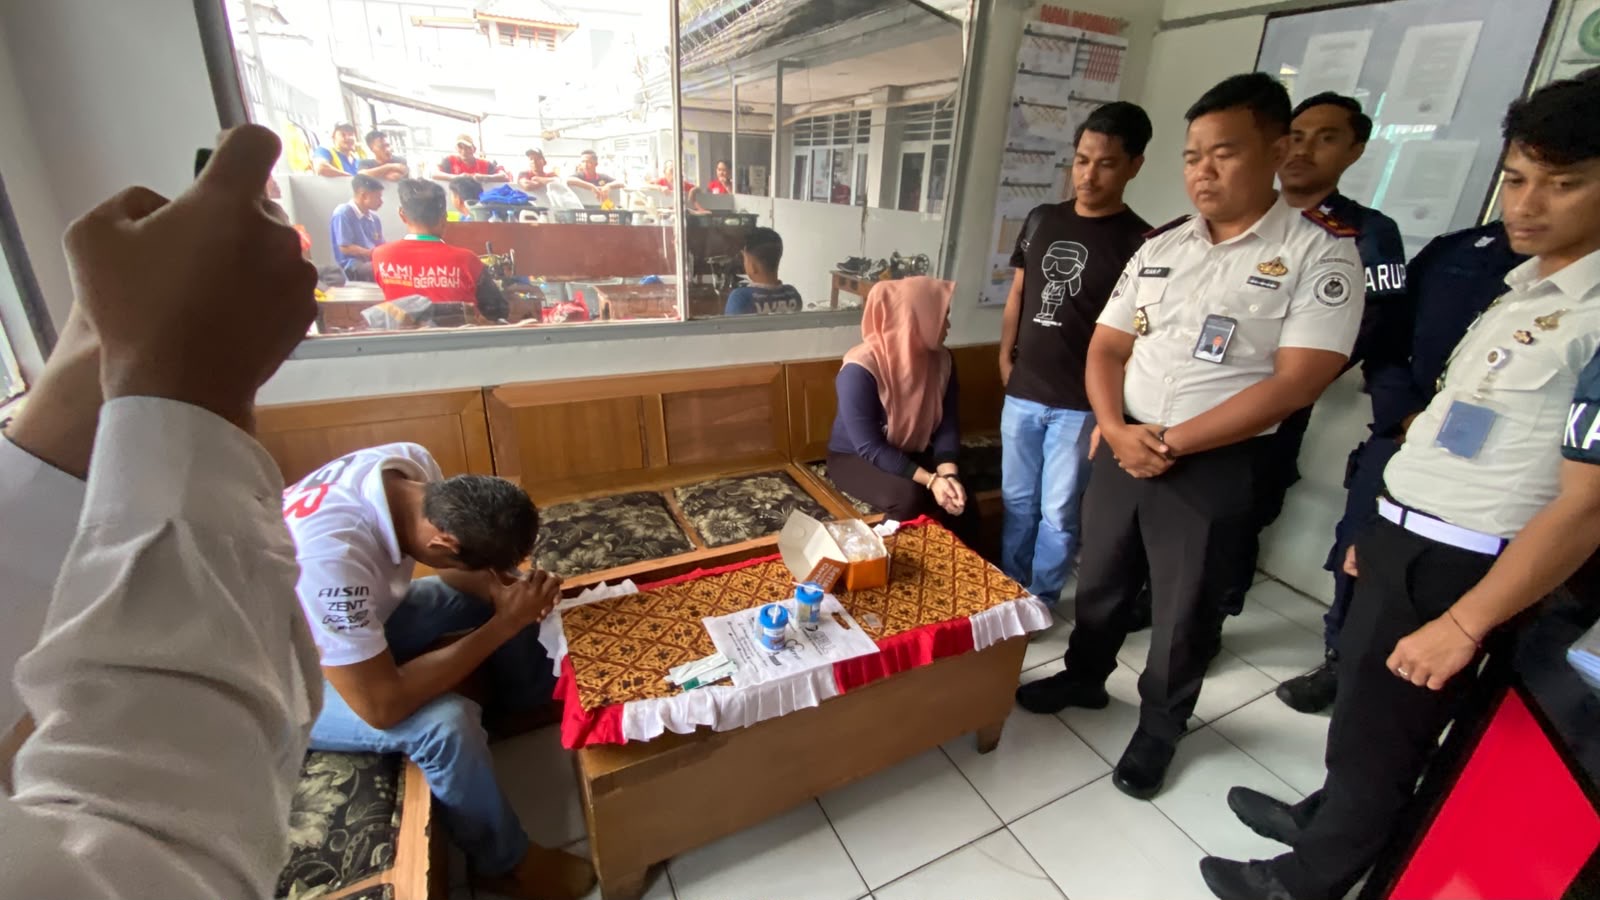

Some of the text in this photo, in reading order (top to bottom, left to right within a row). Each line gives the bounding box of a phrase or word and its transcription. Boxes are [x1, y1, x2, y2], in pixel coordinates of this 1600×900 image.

[378, 262, 413, 279] KAMI
[418, 265, 460, 278] JANJI
[413, 276, 461, 289] BERUBAH
[318, 585, 370, 598] AISIN
[327, 598, 367, 612] ZENT
